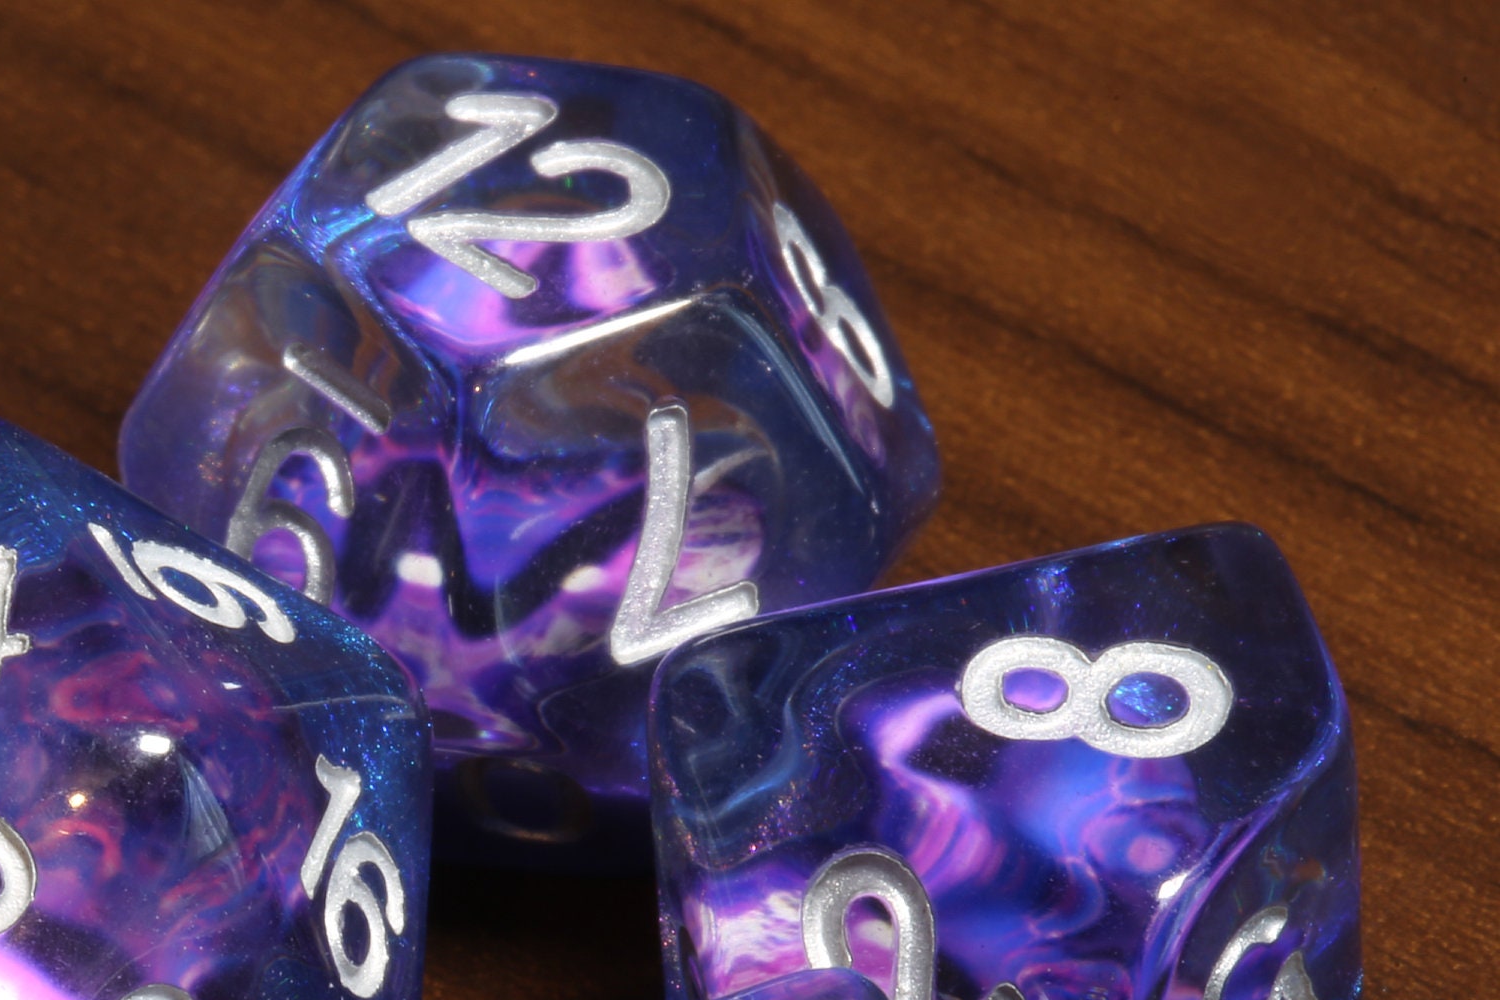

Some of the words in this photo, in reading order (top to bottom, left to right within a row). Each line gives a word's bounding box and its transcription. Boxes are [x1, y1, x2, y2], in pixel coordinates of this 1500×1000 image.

[366, 93, 670, 299] 12
[773, 203, 894, 408] 8
[610, 404, 758, 666] 7
[959, 634, 1234, 759] 8
[300, 754, 406, 998] 16
